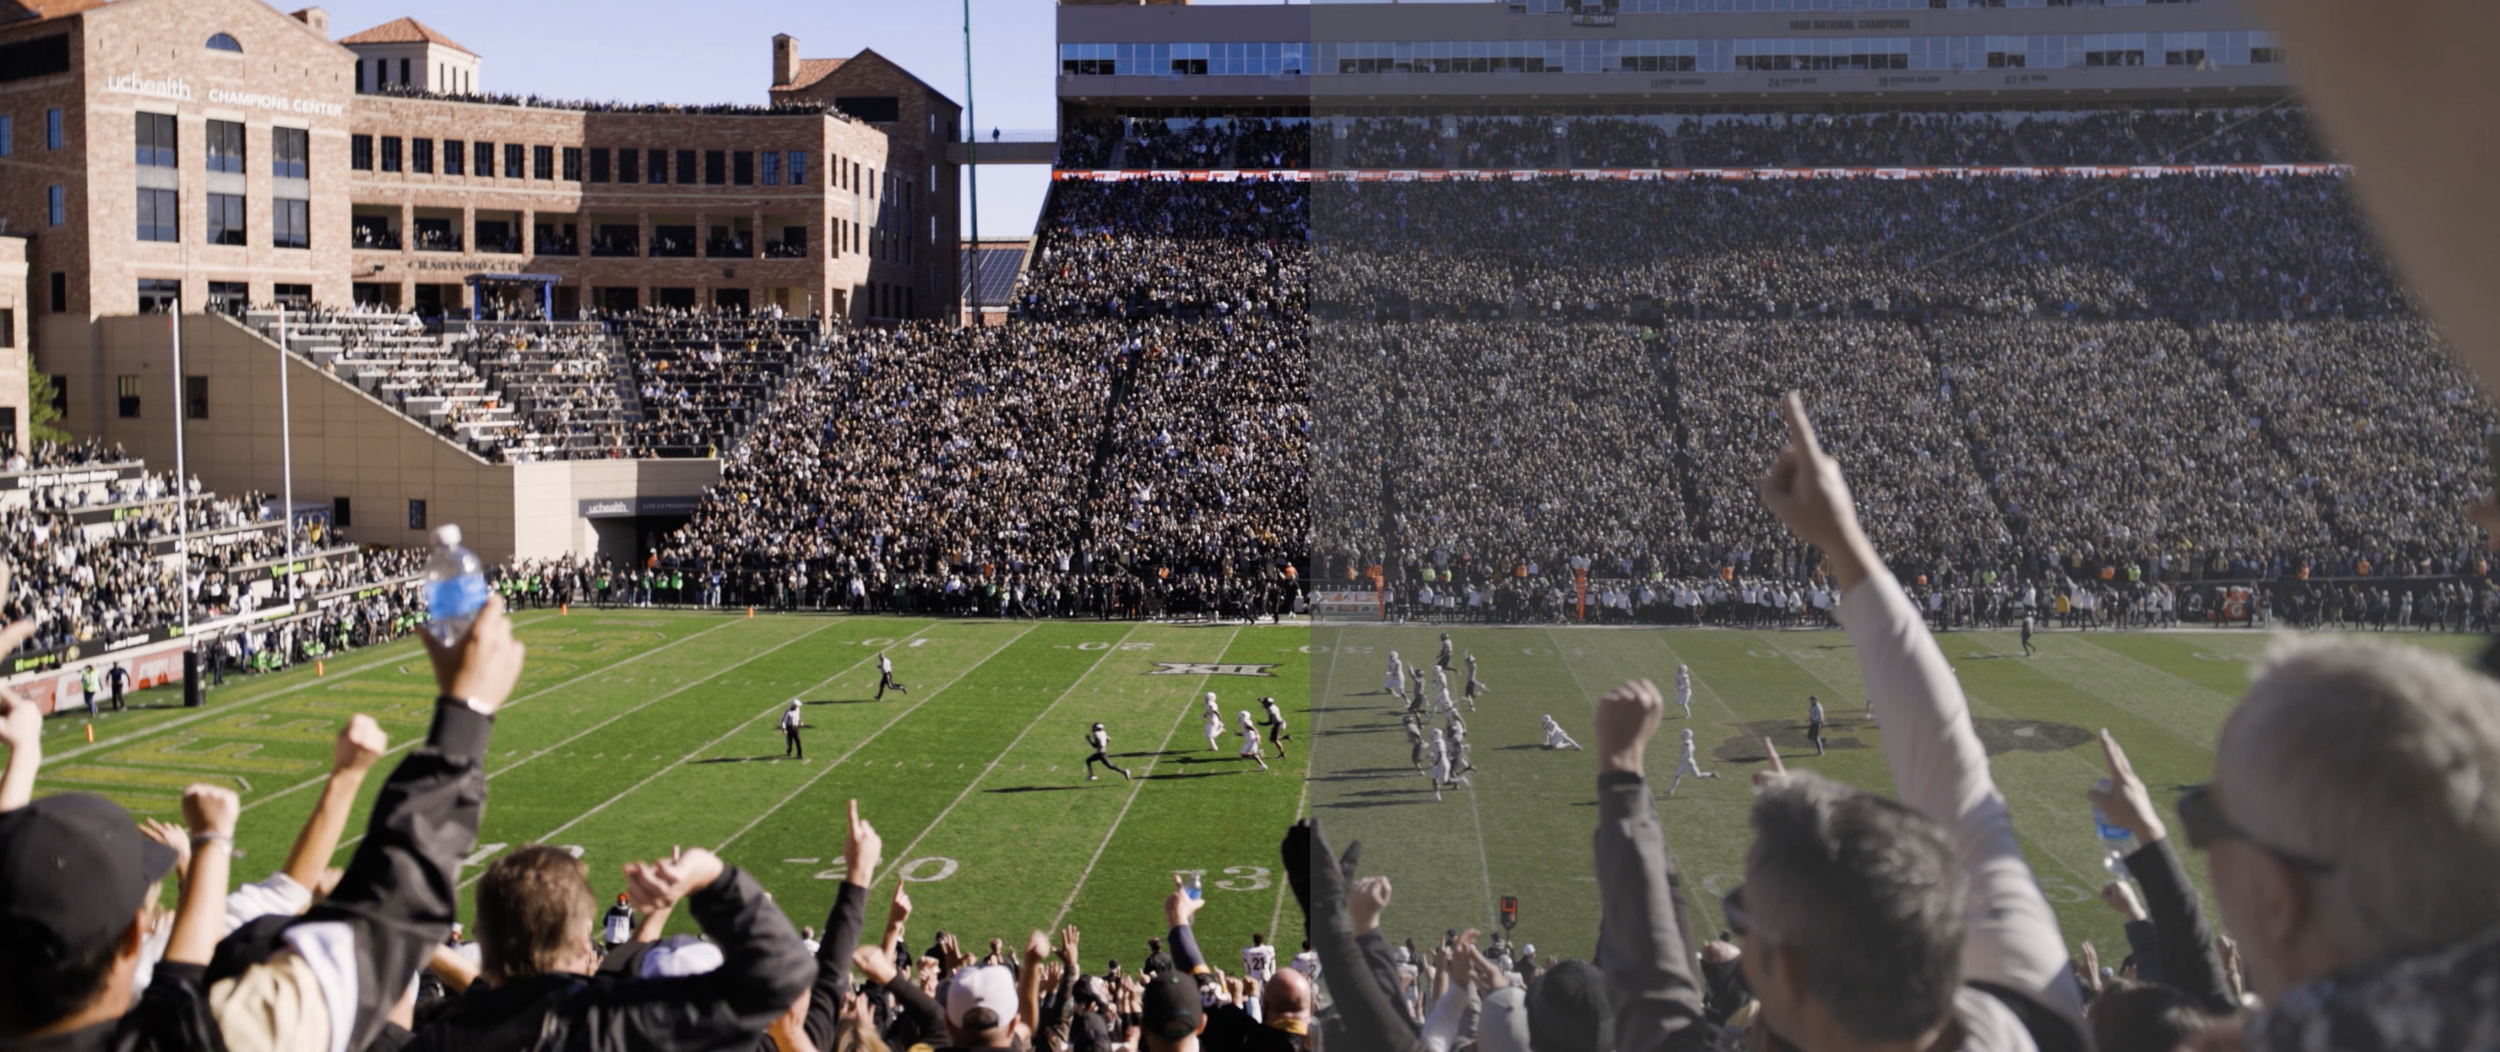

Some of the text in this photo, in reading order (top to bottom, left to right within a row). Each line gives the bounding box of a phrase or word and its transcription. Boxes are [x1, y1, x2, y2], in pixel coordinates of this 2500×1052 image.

[1790, 19, 1910, 30] 1990 NATIONAL CHAMPIONS
[107, 72, 190, 99] uchealth
[208, 89, 343, 116] CHAMPIONS CENTER
[588, 502, 627, 514] uchealth
[1502, 899, 1516, 921] 4
[1252, 957, 1265, 970] 21
